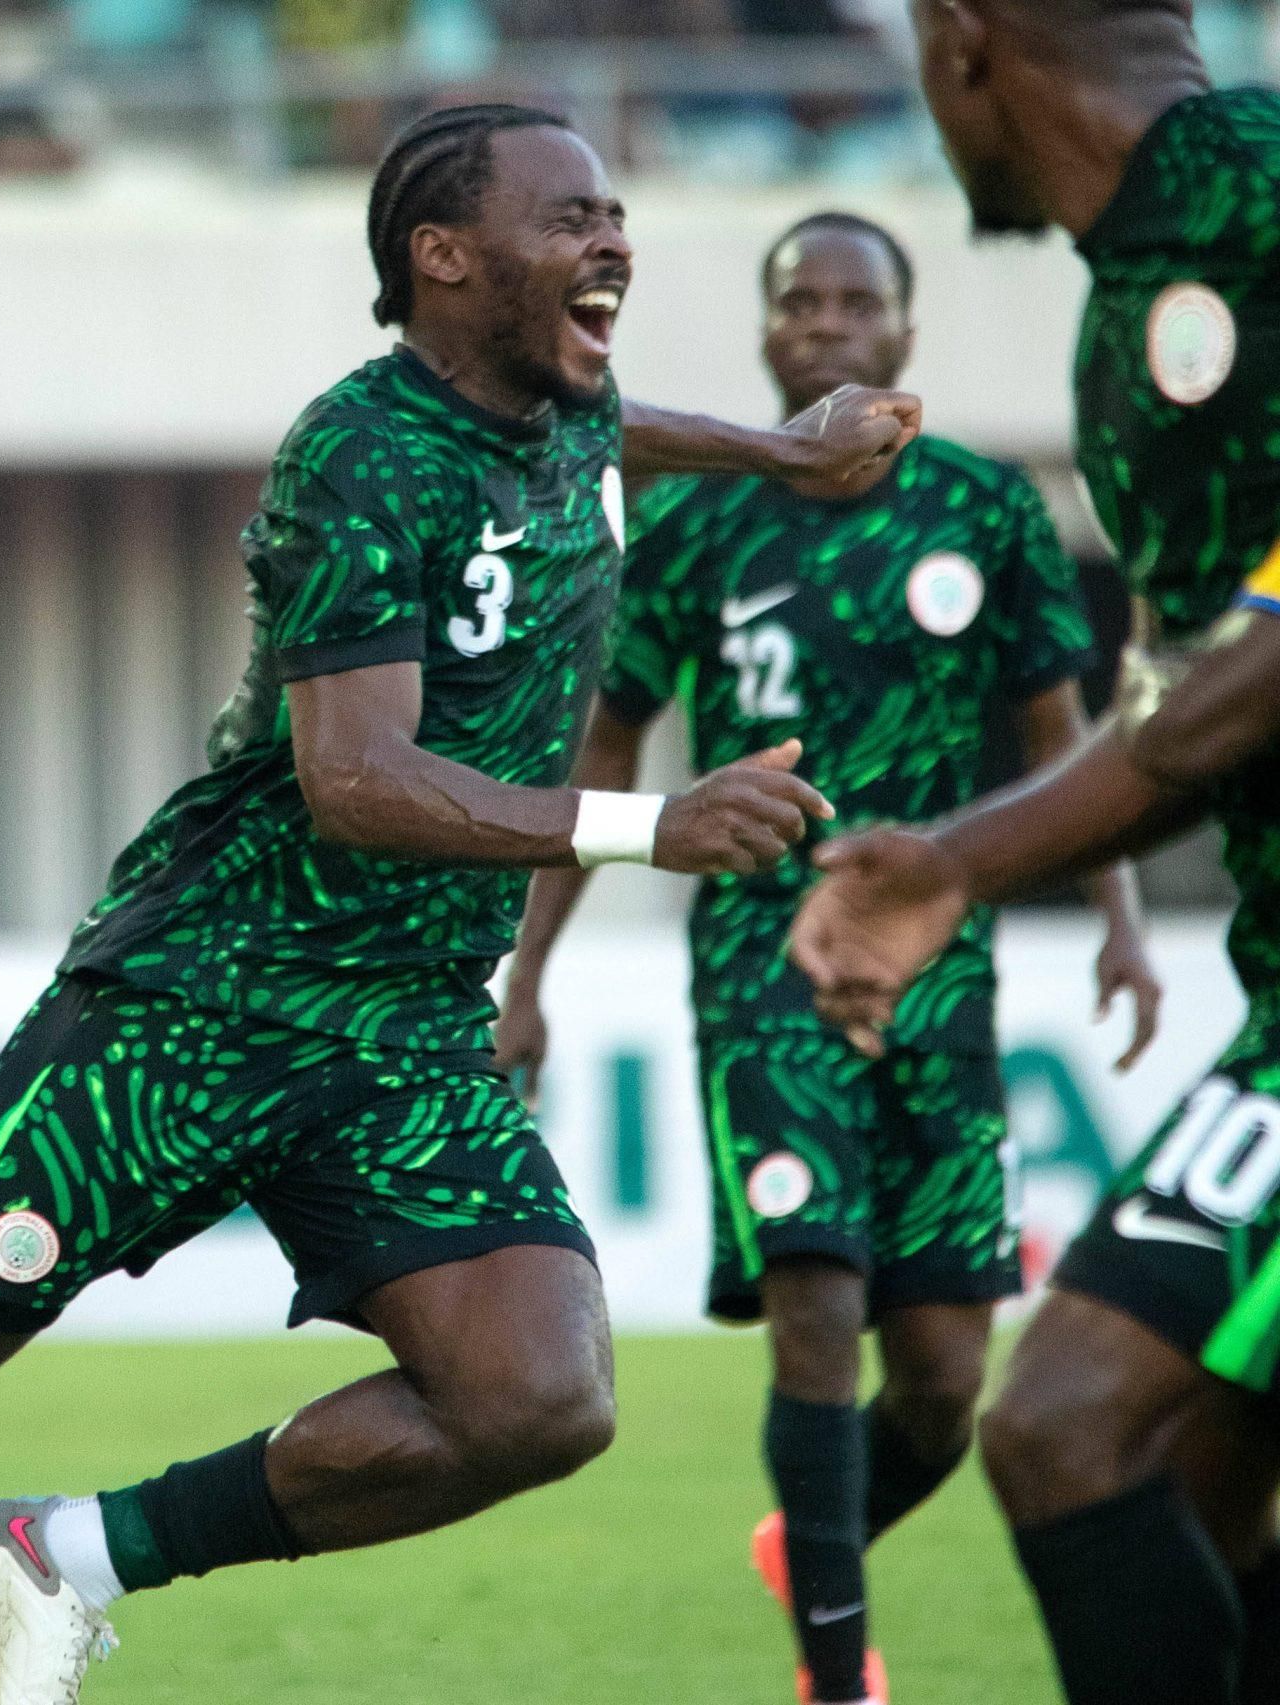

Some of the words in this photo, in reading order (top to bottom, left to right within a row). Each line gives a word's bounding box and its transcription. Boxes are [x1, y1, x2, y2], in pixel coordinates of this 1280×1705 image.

[447, 552, 514, 659] 3
[720, 622, 801, 719] 12
[1143, 1072, 1280, 1228] 10
